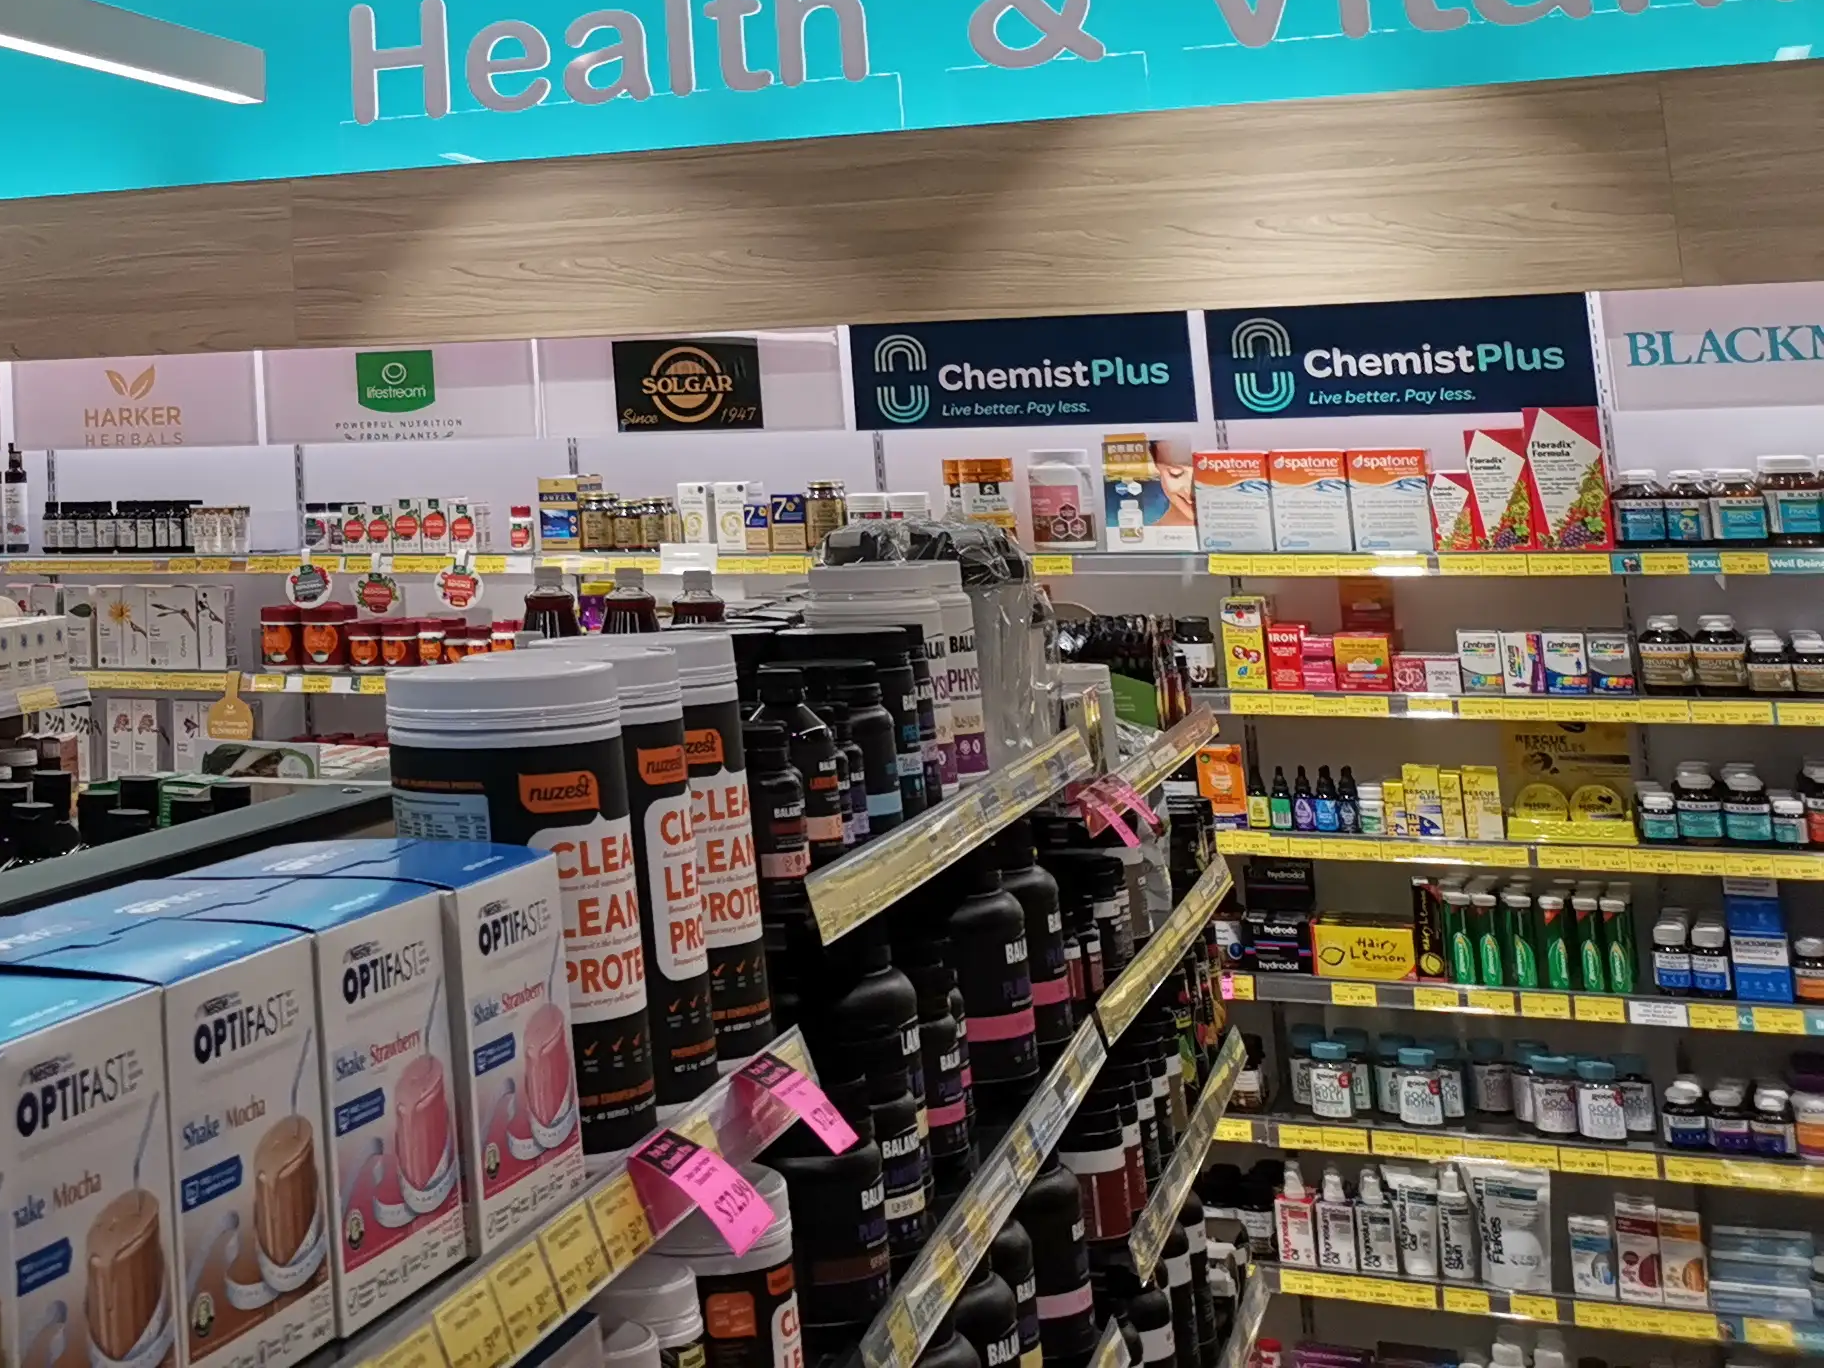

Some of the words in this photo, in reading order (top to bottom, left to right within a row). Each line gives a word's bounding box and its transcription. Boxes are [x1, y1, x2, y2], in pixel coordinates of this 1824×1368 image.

[1303, 341, 1566, 379] ChemistPlus
[939, 357, 1169, 392] ChemistPlus
[642, 375, 734, 394] SOLGAR
[1309, 391, 1342, 406] Live
[1345, 390, 1400, 404] better.
[1405, 388, 1435, 405] Pay
[1438, 387, 1476, 402] less.
[84, 406, 182, 428] HARKER
[621, 408, 659, 425] Since
[721, 407, 756, 423] 1947
[942, 404, 972, 417] Live
[974, 403, 1024, 416] better.
[1027, 402, 1054, 418] Pay
[1057, 400, 1091, 413] less.
[336, 420, 394, 429] POWERFUL
[399, 419, 462, 428] NUTRITION
[85, 431, 184, 447] HERBALS
[359, 433, 390, 441] FROM
[395, 431, 439, 440] PLANTS
[772, 498, 787, 520] 7
[1770, 558, 1795, 569] Well
[1268, 633, 1298, 642] IRON
[1463, 641, 1496, 649] Centrum
[1547, 640, 1580, 648] Centrum
[1591, 641, 1625, 649] Centrum
[685, 731, 716, 754] zest
[1515, 735, 1567, 744] RESCUE
[529, 775, 593, 802] nuzest
[479, 900, 541, 957] OPTIFAST
[1350, 946, 1406, 962] Lemon
[1356, 937, 1398, 955] Hairy
[343, 942, 418, 1005] OPTIFAST
[1258, 960, 1299, 971] hydrodol
[194, 993, 286, 1064] OPTIFAST
[16, 1052, 127, 1138] OPTIFAST
[182, 1114, 220, 1150] Shake
[226, 1093, 266, 1128] Mocha
[53, 1169, 102, 1209] Mocha
[714, 1179, 755, 1224] $72.99
[1490, 1216, 1505, 1266] Flakes
